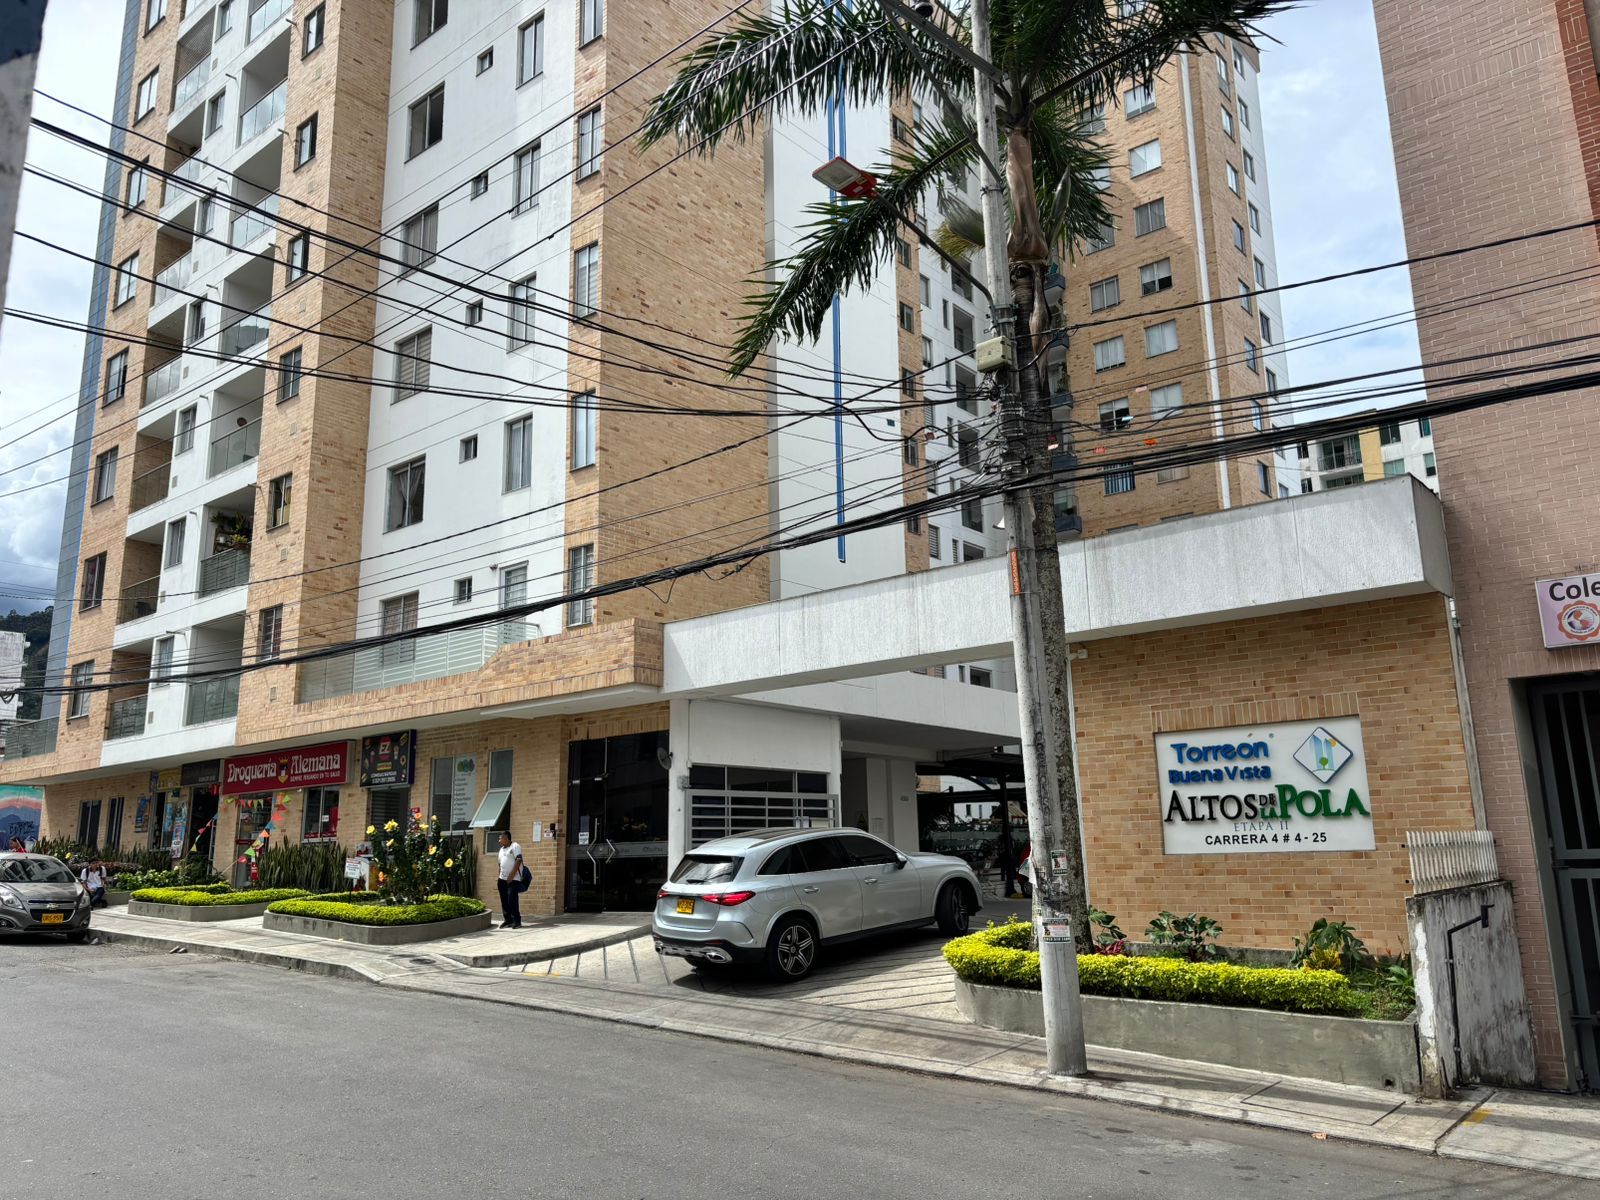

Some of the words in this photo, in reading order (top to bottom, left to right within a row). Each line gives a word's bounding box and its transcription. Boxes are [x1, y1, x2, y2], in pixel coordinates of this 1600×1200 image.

[227, 758, 277, 784] Droguería
[290, 754, 340, 774] Alemana
[1168, 768, 1223, 784] Buena
[1224, 765, 1272, 781] Vista
[1164, 790, 1258, 822] ALTOS
[1259, 793, 1276, 806] DE
[1275, 784, 1370, 819] POLA
[1260, 807, 1279, 819] LA
[1234, 821, 1274, 832] ETAPA
[1205, 834, 1268, 845] CARRERA
[1271, 833, 1279, 843] 4
[1282, 833, 1290, 843] #
[1294, 832, 1302, 843] 4
[1312, 832, 1327, 843] 25
